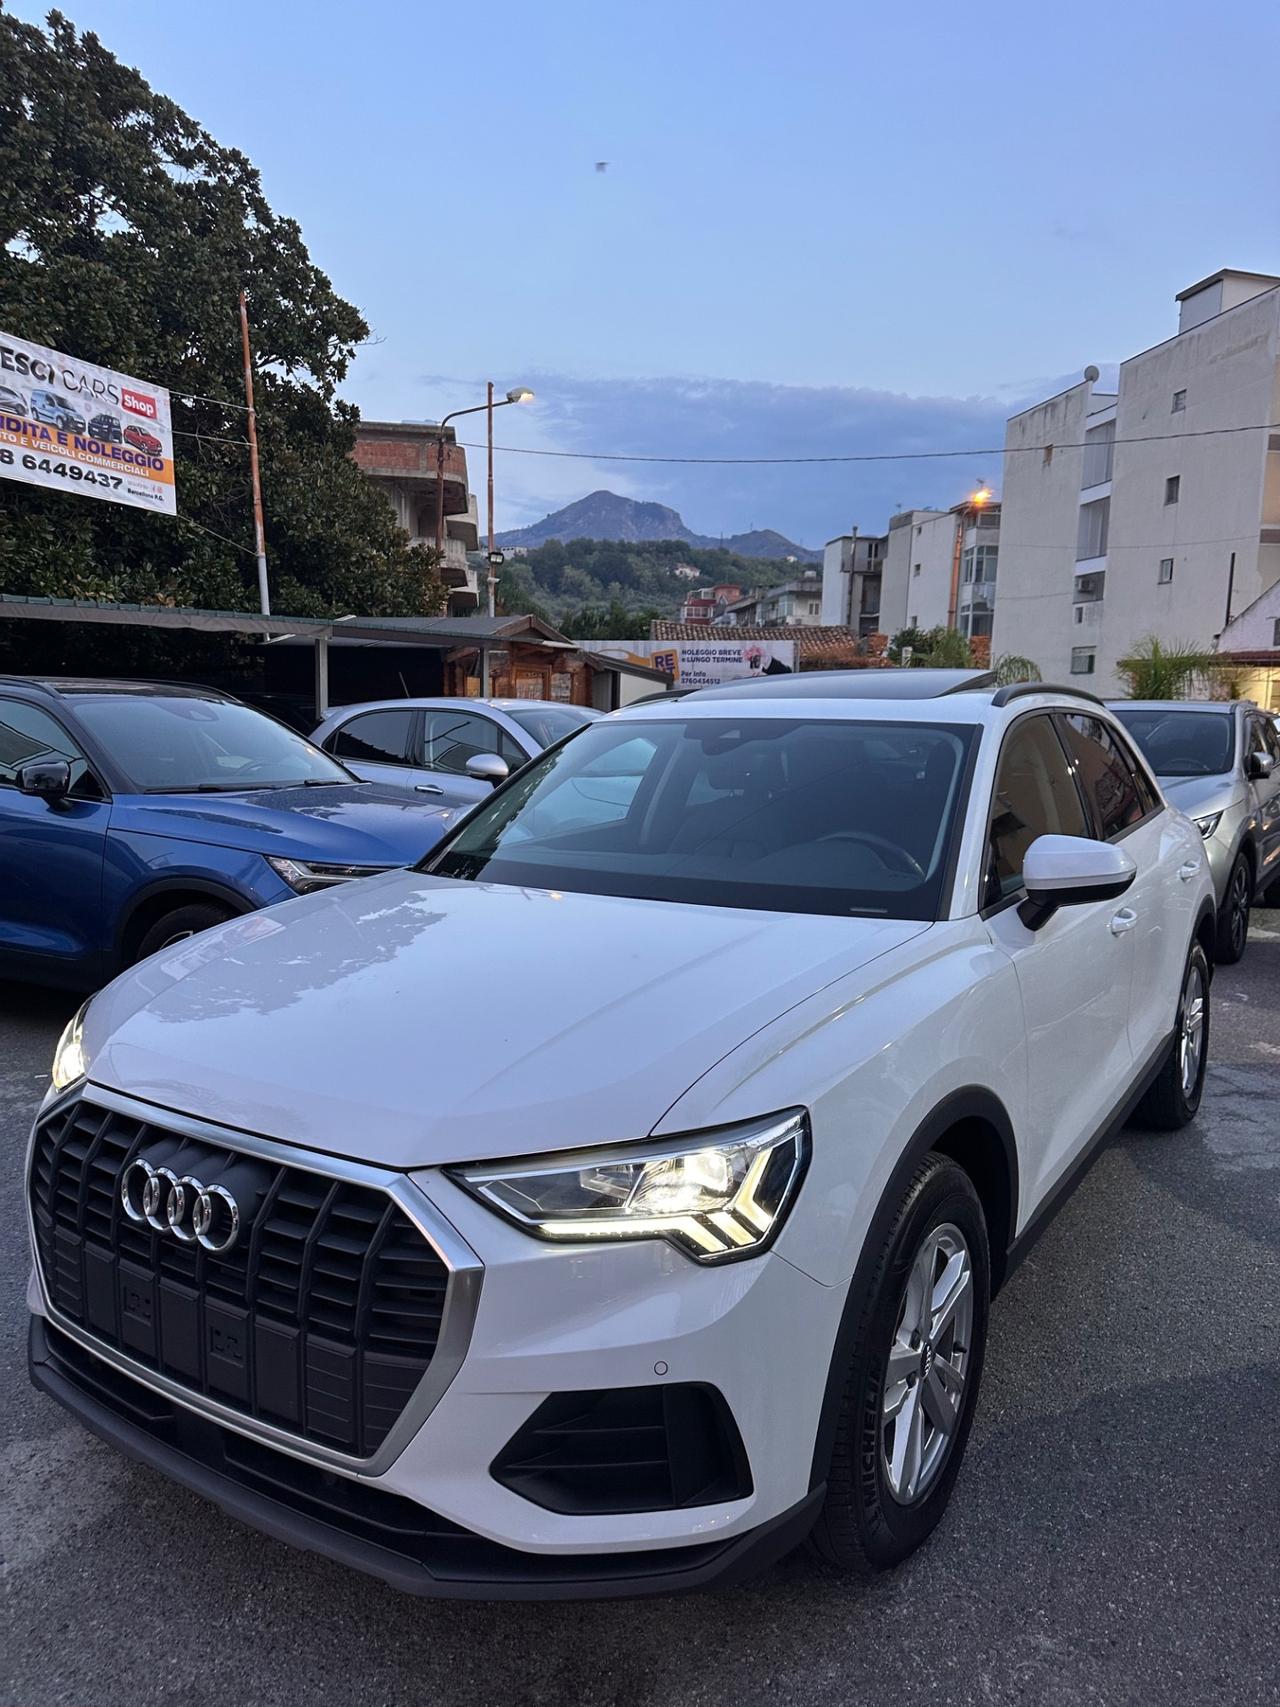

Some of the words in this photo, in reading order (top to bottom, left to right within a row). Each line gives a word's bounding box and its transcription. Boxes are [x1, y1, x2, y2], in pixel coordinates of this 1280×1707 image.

[62, 369, 120, 405] CARS
[123, 394, 154, 416] Shop
[0, 448, 14, 465] 8
[22, 454, 123, 489] 6449437
[20, 436, 29, 446] E
[31, 439, 75, 458] VEICOLI
[78, 452, 149, 477] COMMERCIALI
[57, 431, 69, 447] E
[74, 436, 164, 471] NOLEGGIO
[655, 653, 674, 669] RE
[862, 1352, 882, 1507] MICHELIN
